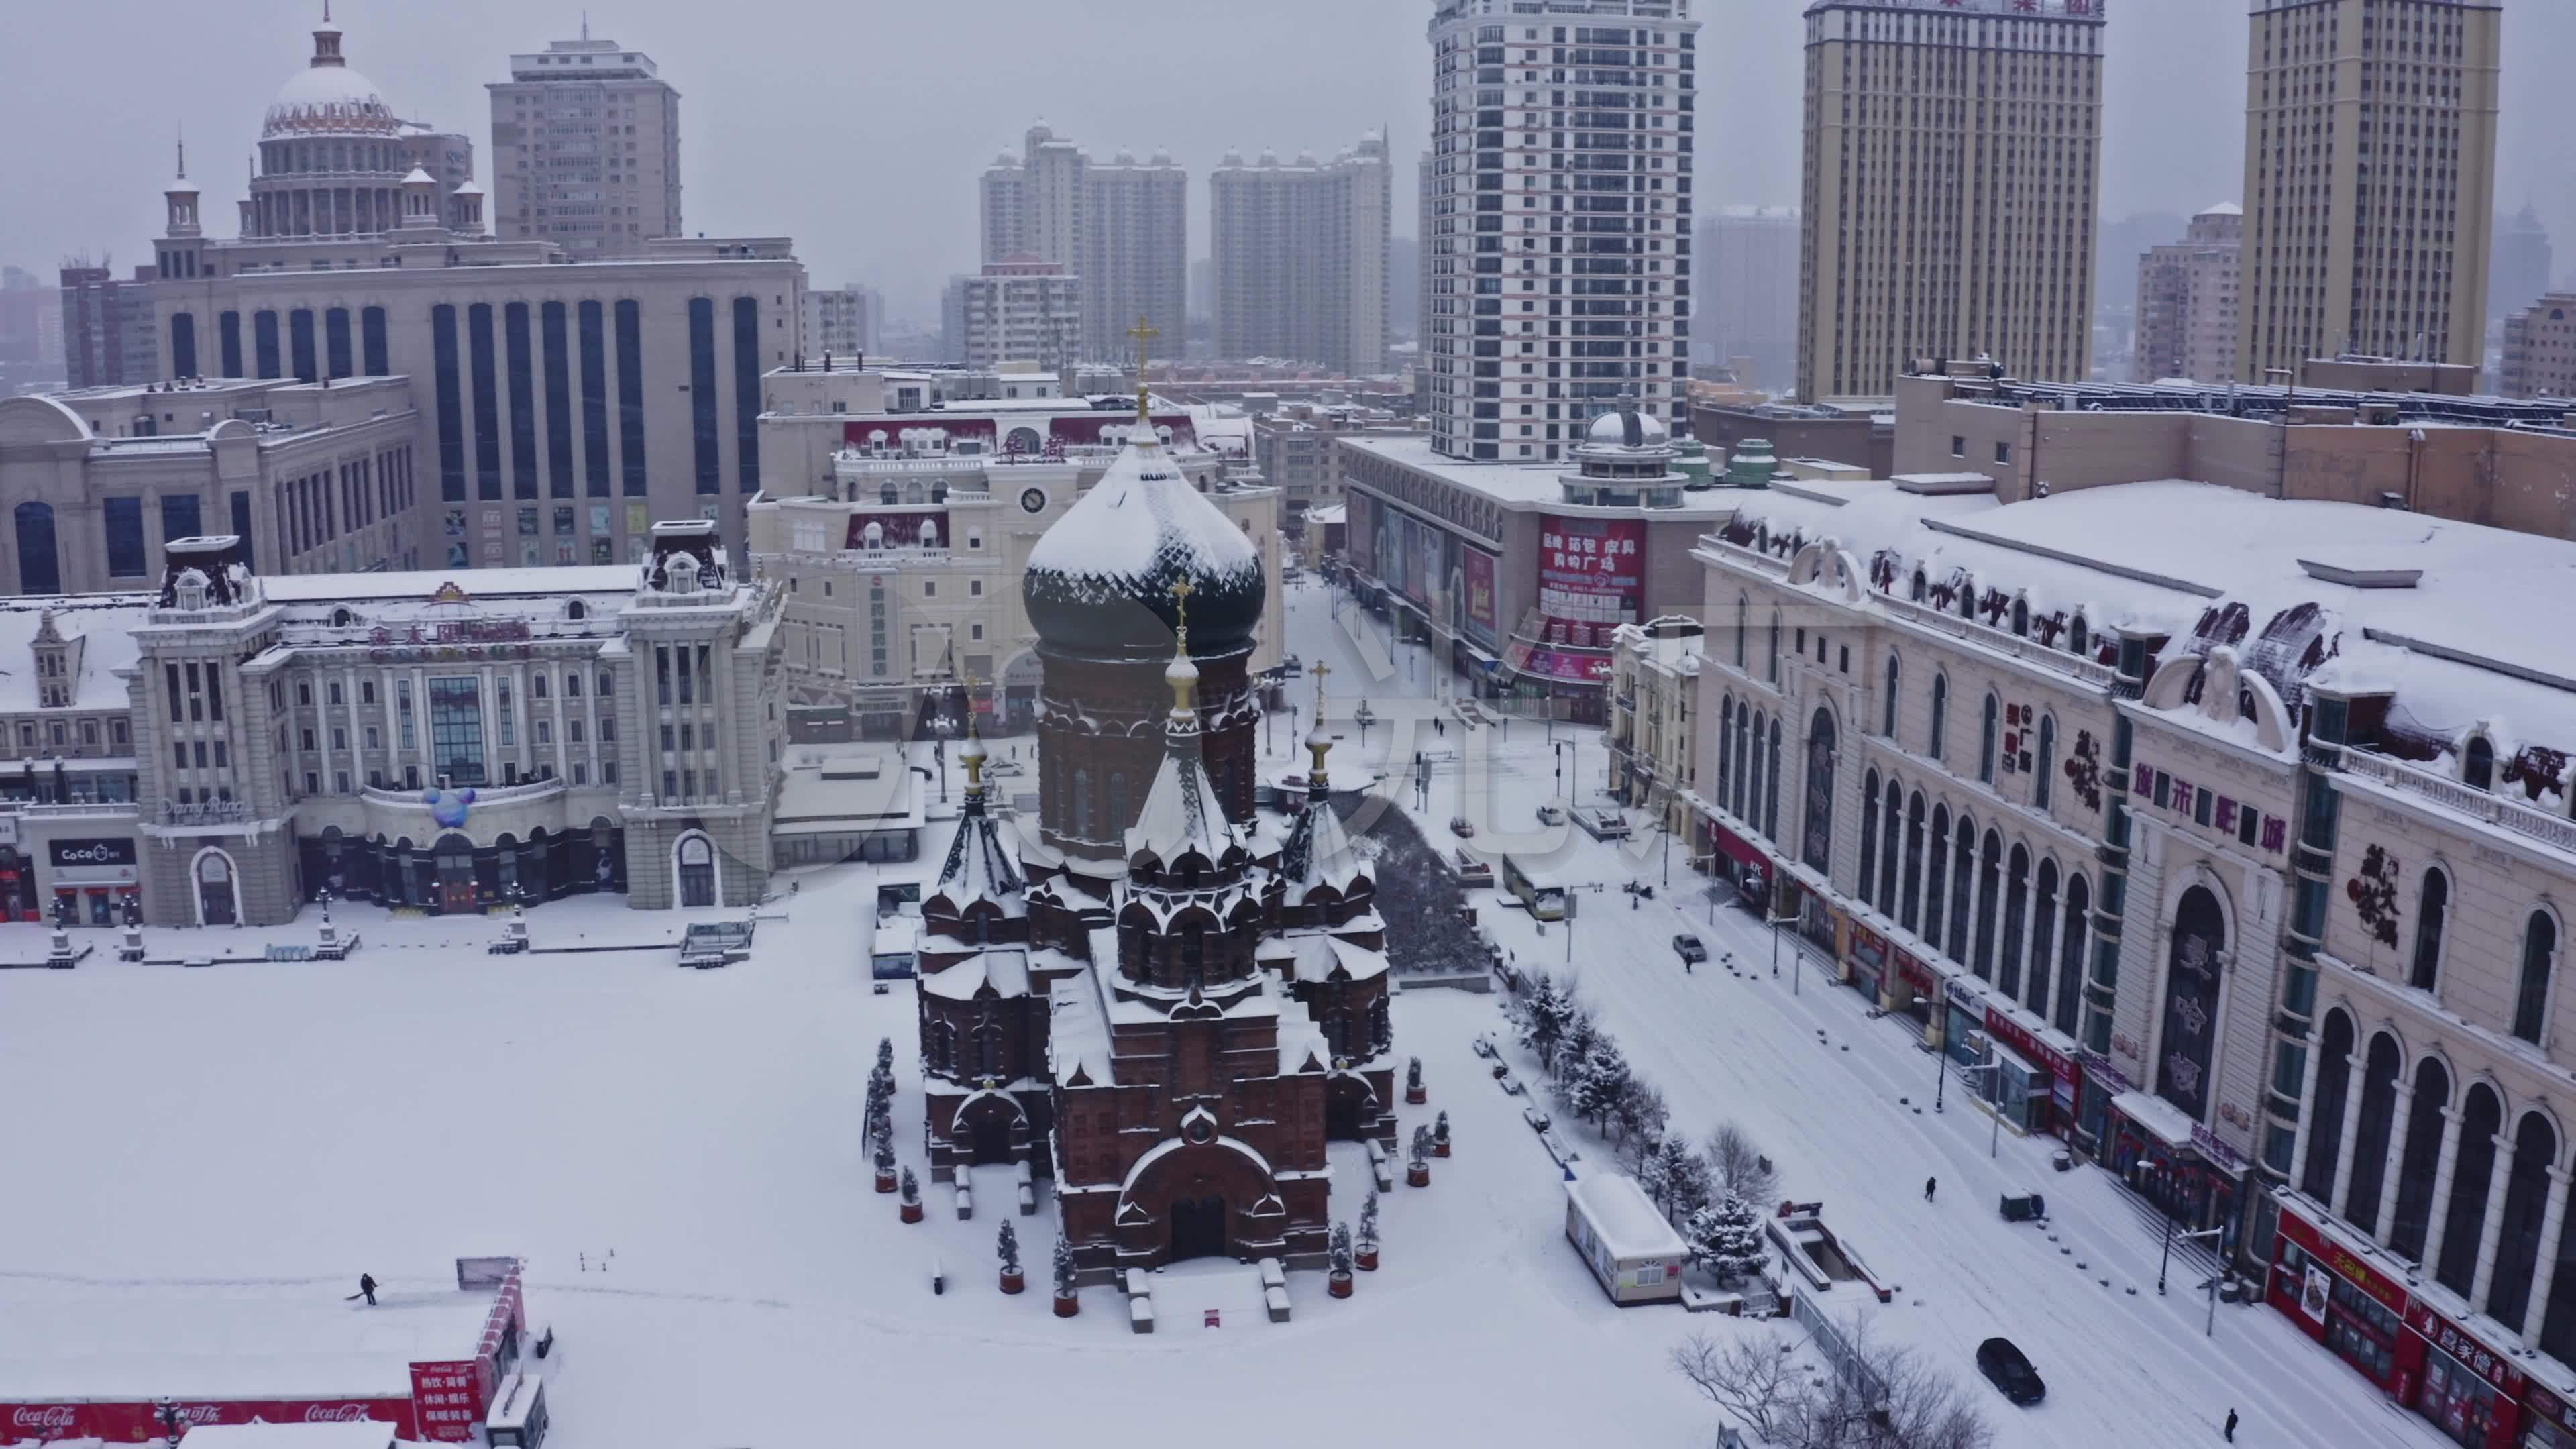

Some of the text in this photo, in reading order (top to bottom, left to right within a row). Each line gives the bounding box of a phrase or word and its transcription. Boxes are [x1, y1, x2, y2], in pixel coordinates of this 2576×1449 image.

[1554, 552, 1615, 572] 购物广场
[1749, 859, 1763, 876] KFC
[2440, 1327, 2492, 1375] 喜家德
[13, 1406, 76, 1426] Coca-Cola
